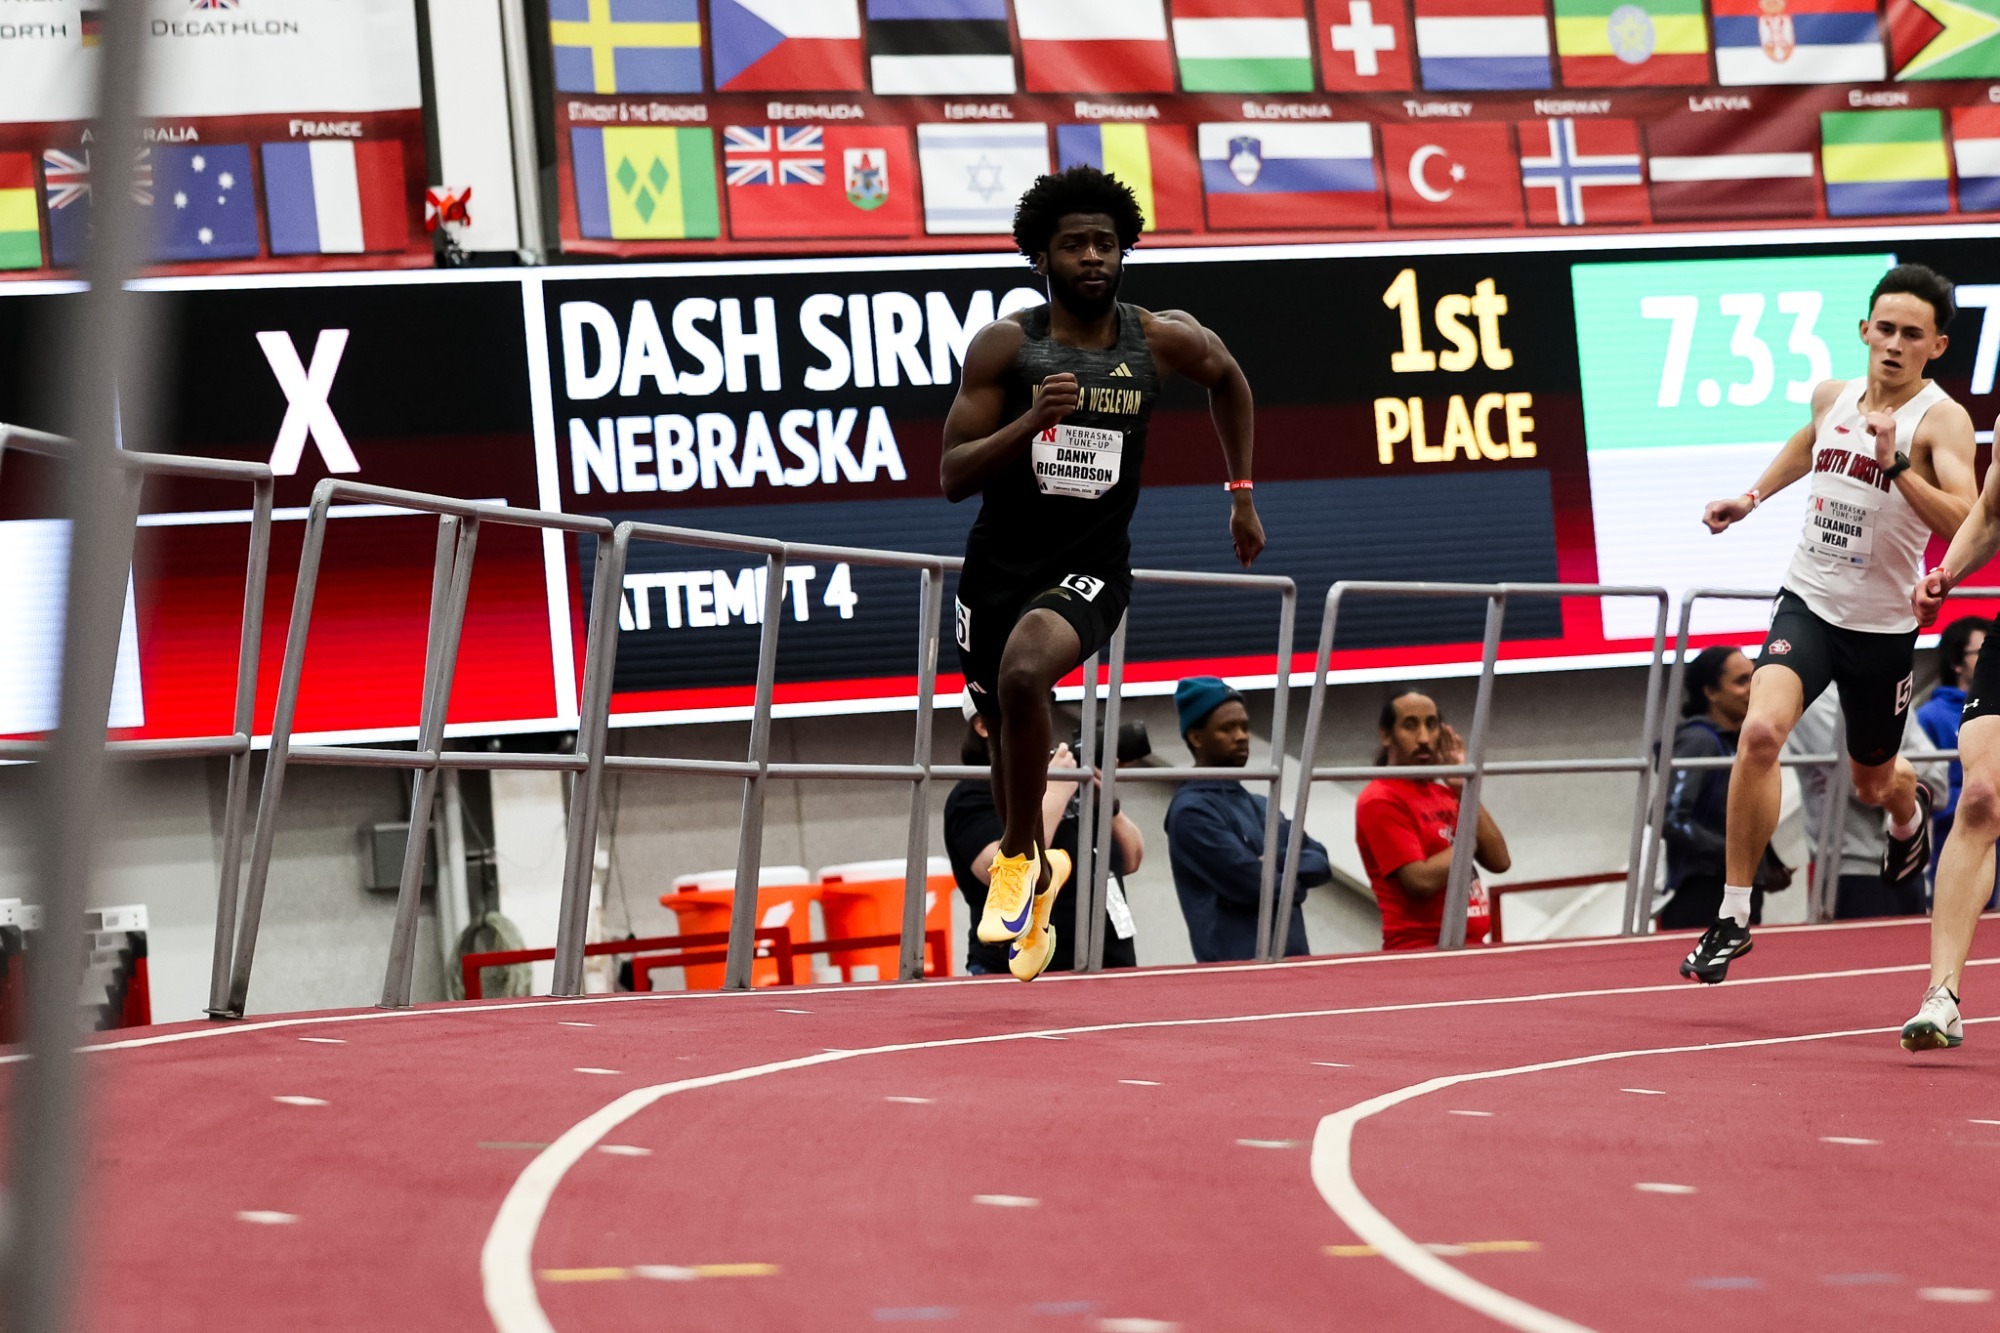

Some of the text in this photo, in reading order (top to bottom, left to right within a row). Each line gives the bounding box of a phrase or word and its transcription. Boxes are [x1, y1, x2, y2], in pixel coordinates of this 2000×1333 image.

[151, 19, 299, 37] DECATHLON
[766, 102, 865, 120] BERMUDA
[944, 102, 1014, 120] ISRAEL
[1074, 101, 1160, 119] ROMANIA
[1242, 101, 1333, 119] SLOVENIA
[1402, 100, 1473, 117] TURKEY
[1533, 98, 1612, 116] NORWAY
[1688, 95, 1752, 112] LATVIA
[81, 126, 199, 144] ARALIA
[289, 119, 363, 137] FRANCE
[1383, 268, 1514, 373] 1st
[559, 297, 782, 400] DASH
[1640, 291, 1833, 408] 7.33
[256, 329, 361, 475] X
[1089, 387, 1142, 415] WESLEYAN
[1066, 428, 1113, 442] NEBRASKA
[1374, 392, 1537, 465] PLACE
[568, 406, 907, 495] NEBRASKA
[1069, 437, 1110, 449] TUNE-UP
[1056, 448, 1097, 465] DANNY
[1815, 448, 1852, 475] SOUTH
[1036, 461, 1113, 482] RICHARDSON
[1830, 501, 1866, 516] NEBRASKA
[1832, 509, 1863, 522] TUNE-UP
[1813, 515, 1862, 538] ALEXANDER
[1821, 531, 1848, 549] WEAR
[823, 562, 859, 620] 4
[1067, 575, 1096, 596] 6
